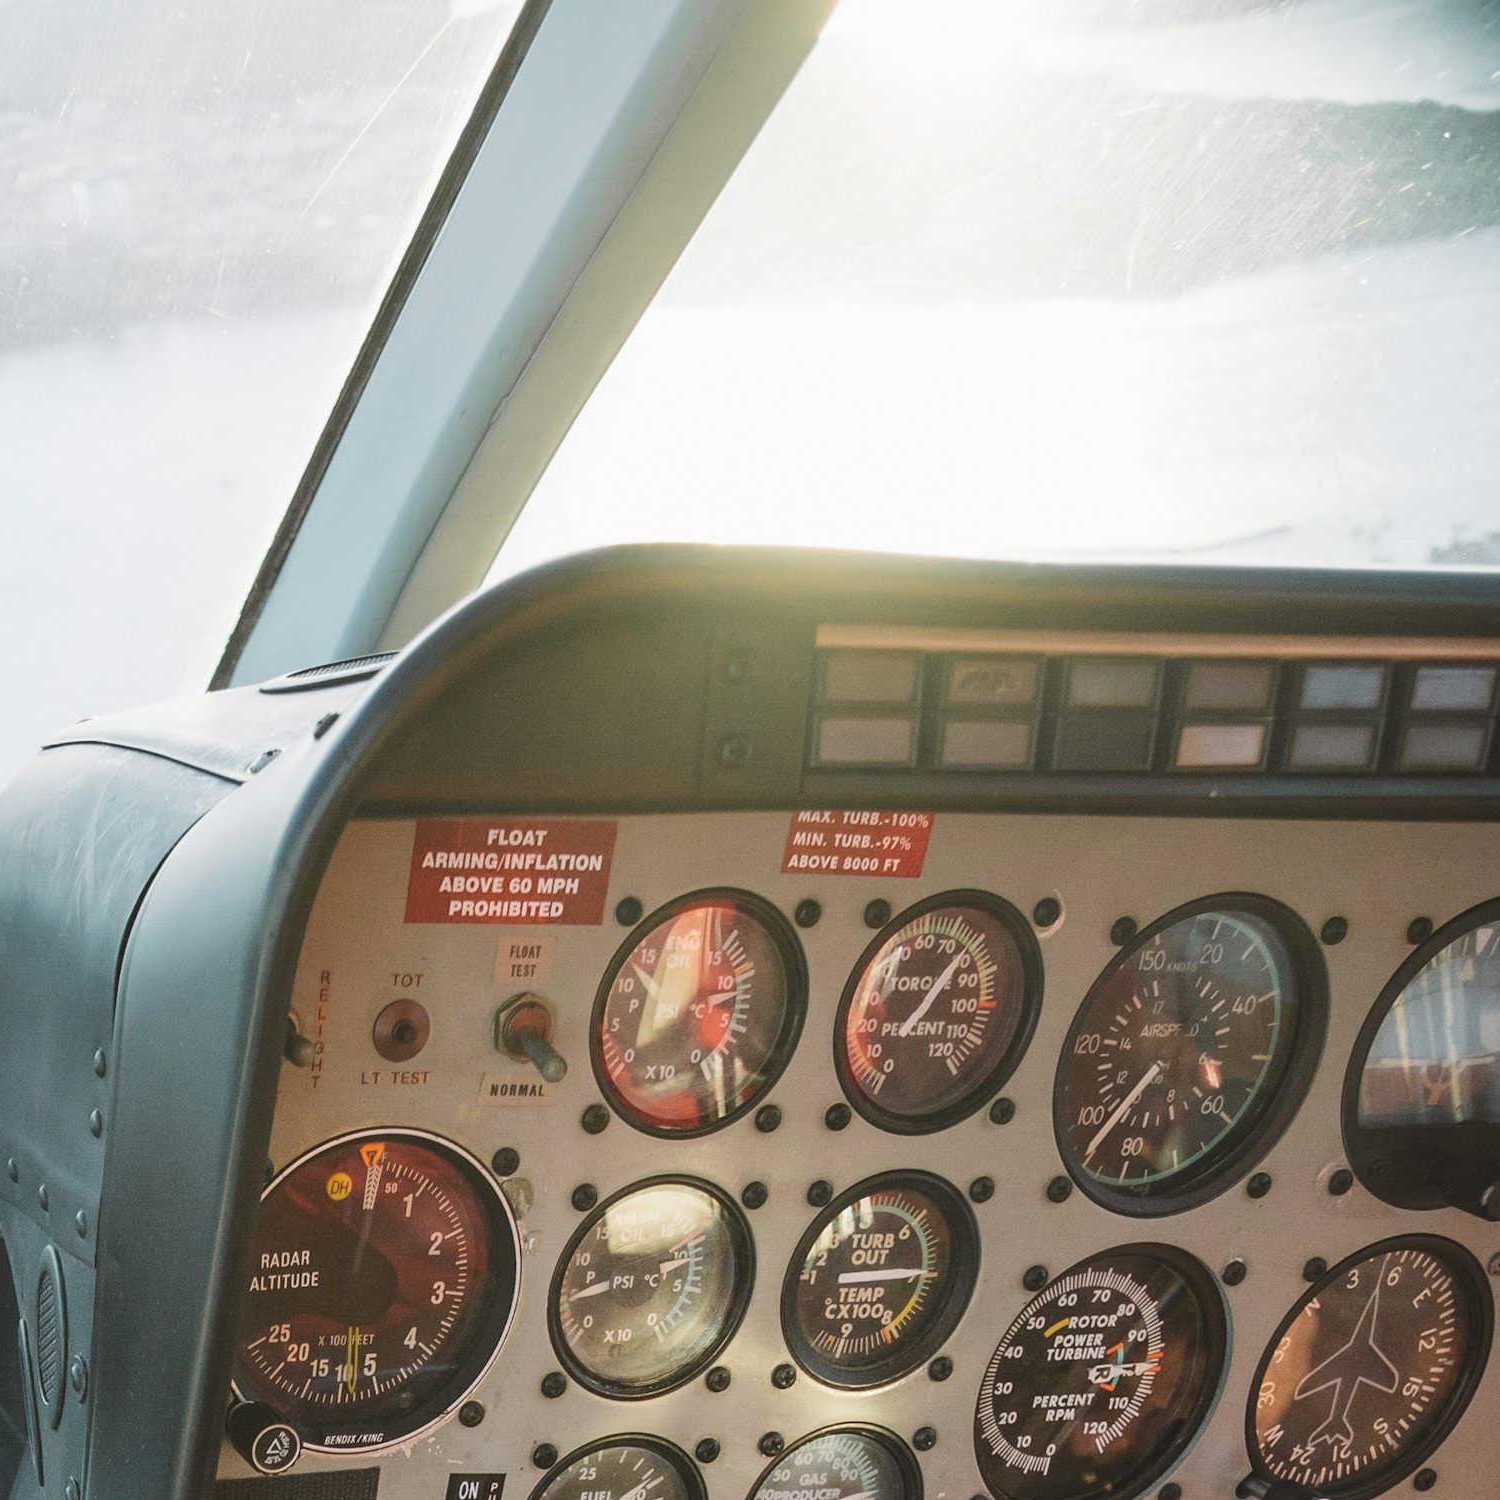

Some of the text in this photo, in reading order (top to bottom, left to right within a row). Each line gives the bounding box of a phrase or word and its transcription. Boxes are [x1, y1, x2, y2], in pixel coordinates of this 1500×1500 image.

[798, 812, 835, 823] MAX.
[488, 830, 547, 846] FLOAT
[793, 832, 911, 850] MIN. TURB.-97%
[422, 853, 602, 870] ARMING/INFLATION
[788, 855, 900, 871] ABOVE 8000 FT
[440, 877, 579, 893] ABOVE 60 MPH
[449, 901, 563, 917] PROHIBITED
[510, 946, 541, 958] FLOAT
[511, 965, 535, 977] TEST
[393, 974, 424, 987] TOT
[958, 974, 978, 987] 90
[952, 999, 977, 1012] 100
[1074, 1035, 1100, 1054] 120
[361, 1072, 430, 1084] LT TEST
[490, 1085, 544, 1096] NORMAL
[1121, 1138, 1143, 1155] 80
[330, 1180, 349, 1194] DH
[852, 1234, 894, 1248] TURB
[261, 1251, 310, 1268] RADAR
[852, 1250, 889, 1264] OUT
[250, 1272, 319, 1291] ALTITUDE
[431, 1281, 445, 1304] 3
[839, 1288, 884, 1302] TEMP
[1058, 1294, 1077, 1306] 60
[1069, 1315, 1117, 1328] ROTOR
[270, 1325, 290, 1343] 25
[1054, 1334, 1103, 1347] POWER
[1047, 1347, 1106, 1360] TURBINE
[1032, 1393, 1094, 1407] PERCENT
[1046, 1409, 1075, 1421] RPM
[800, 1474, 827, 1486] GAS
[459, 1481, 479, 1500] ON
